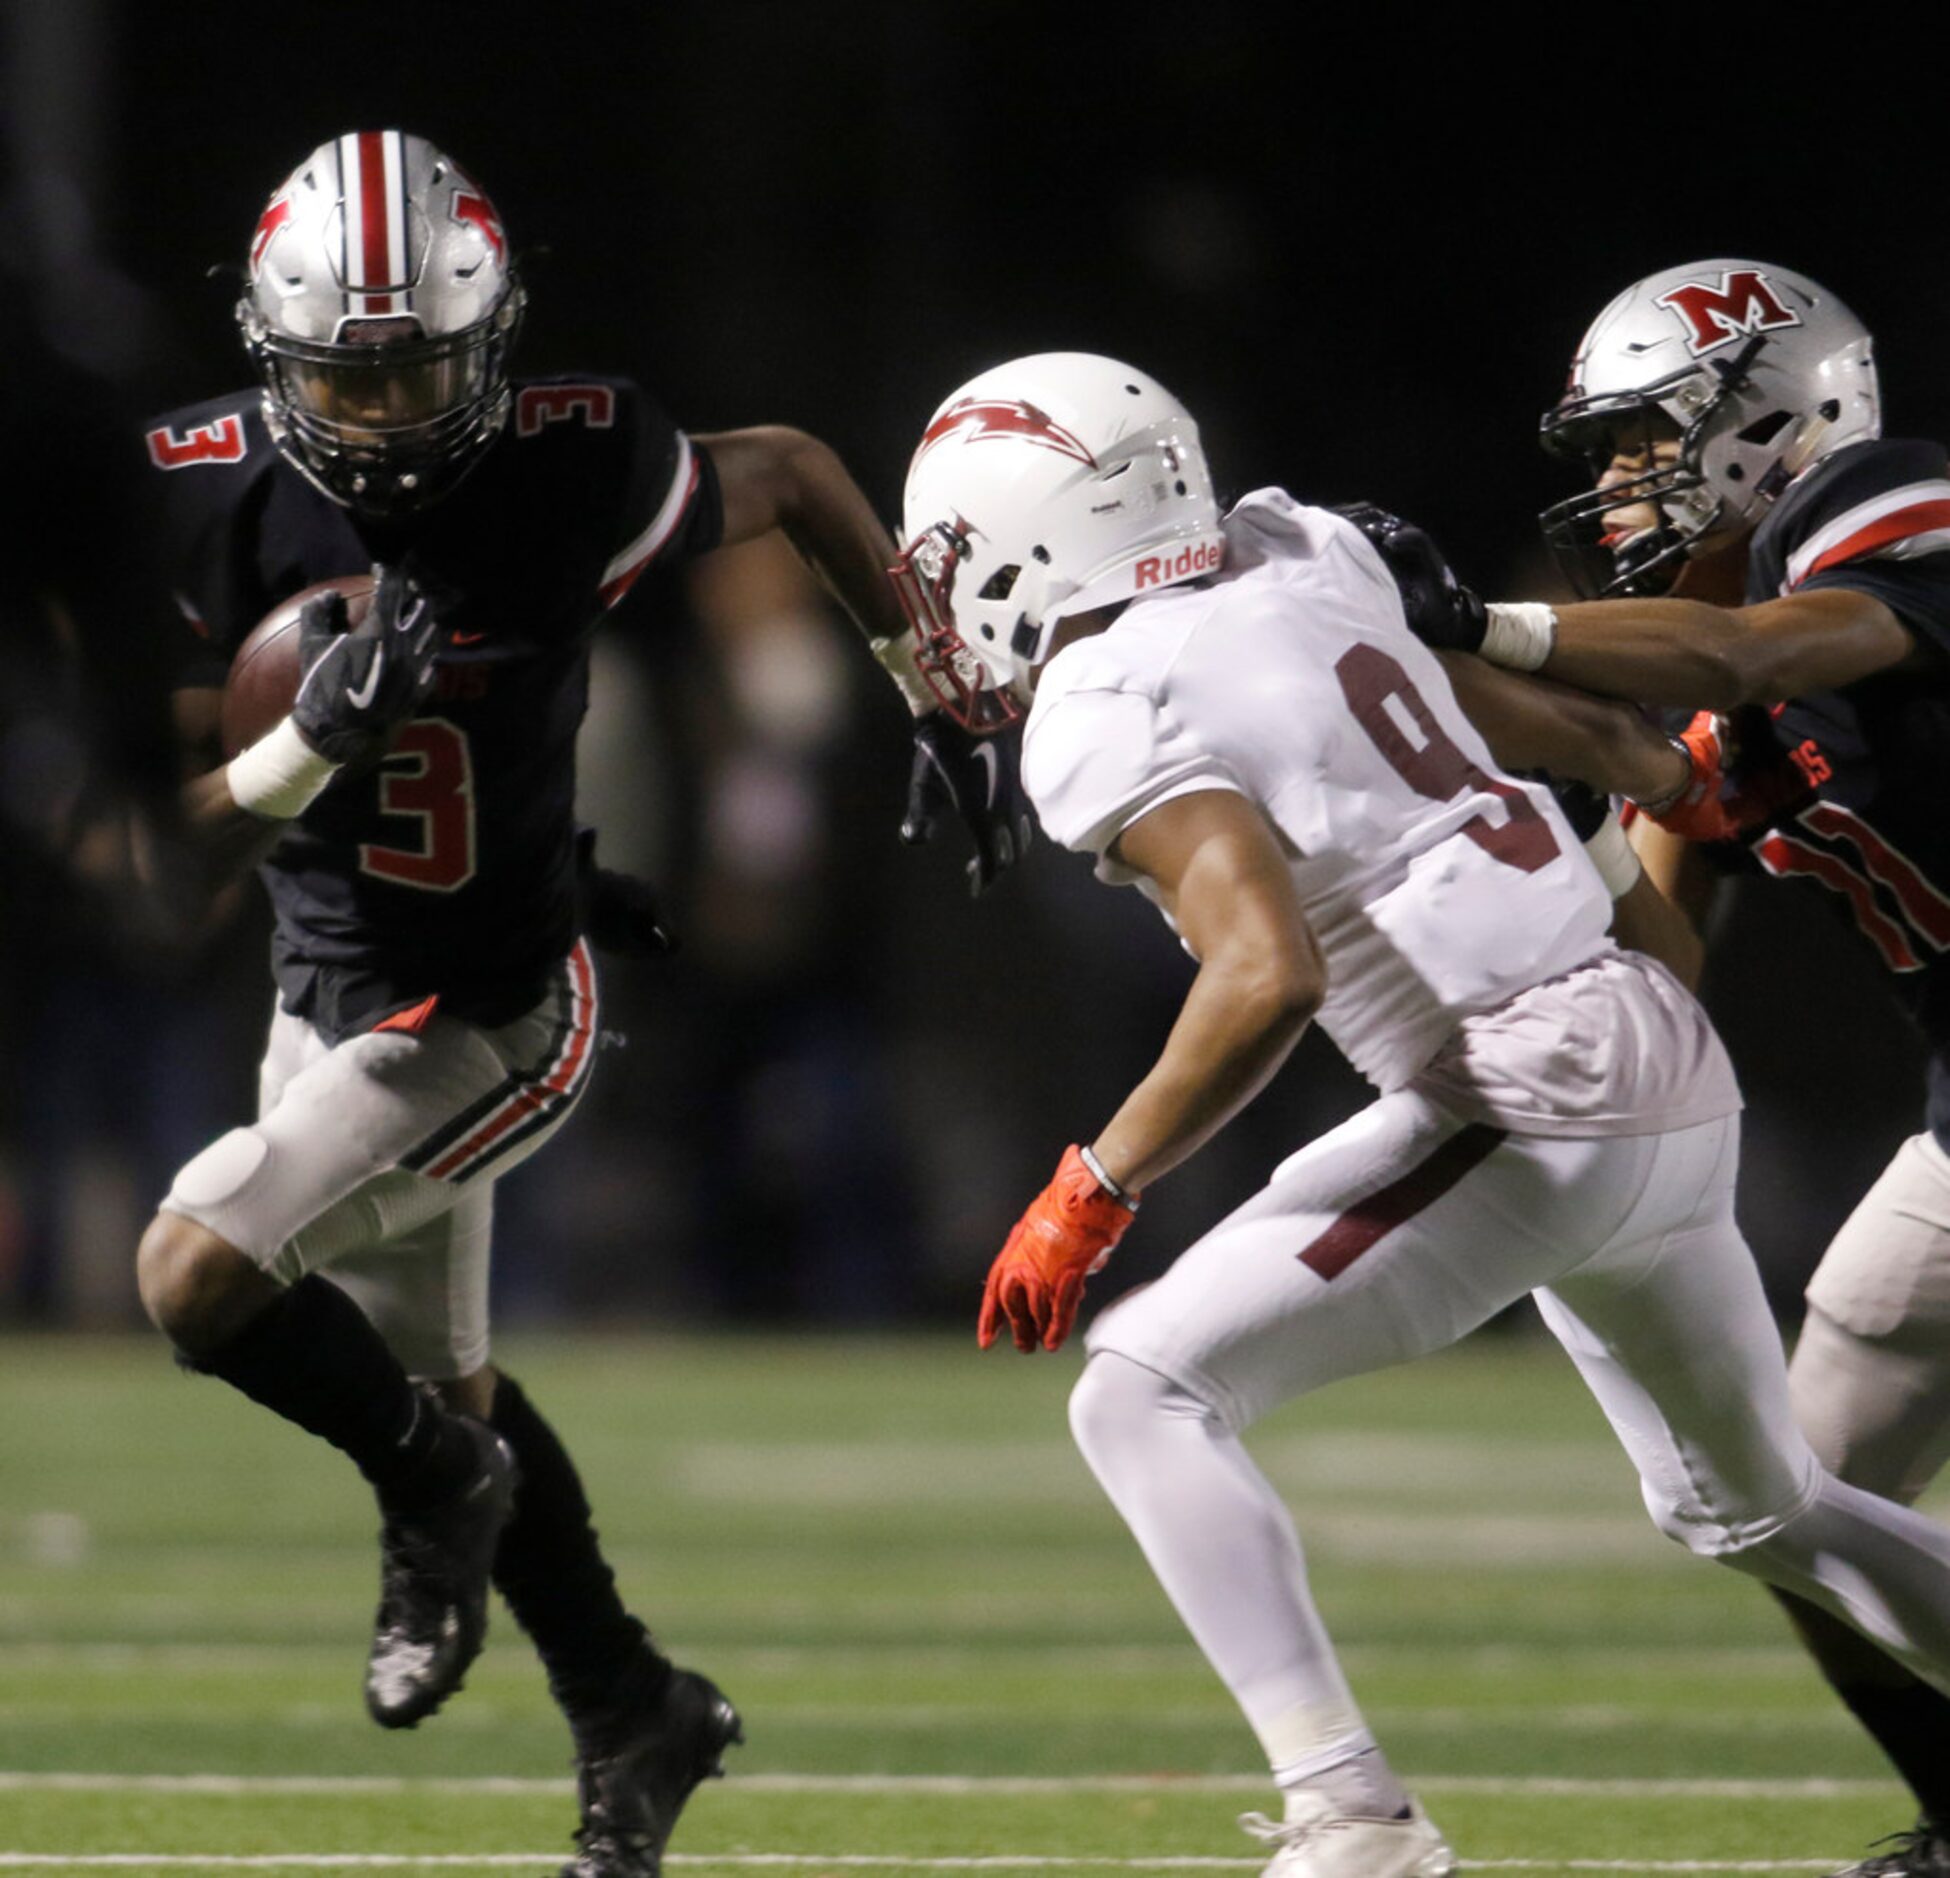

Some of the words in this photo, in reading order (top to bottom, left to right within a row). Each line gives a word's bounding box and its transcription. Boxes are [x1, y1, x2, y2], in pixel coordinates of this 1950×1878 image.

[1653, 269, 1802, 359] M
[145, 413, 248, 471] 3
[515, 384, 614, 437] 3
[1334, 641, 1562, 874] 9
[359, 717, 476, 893] 3
